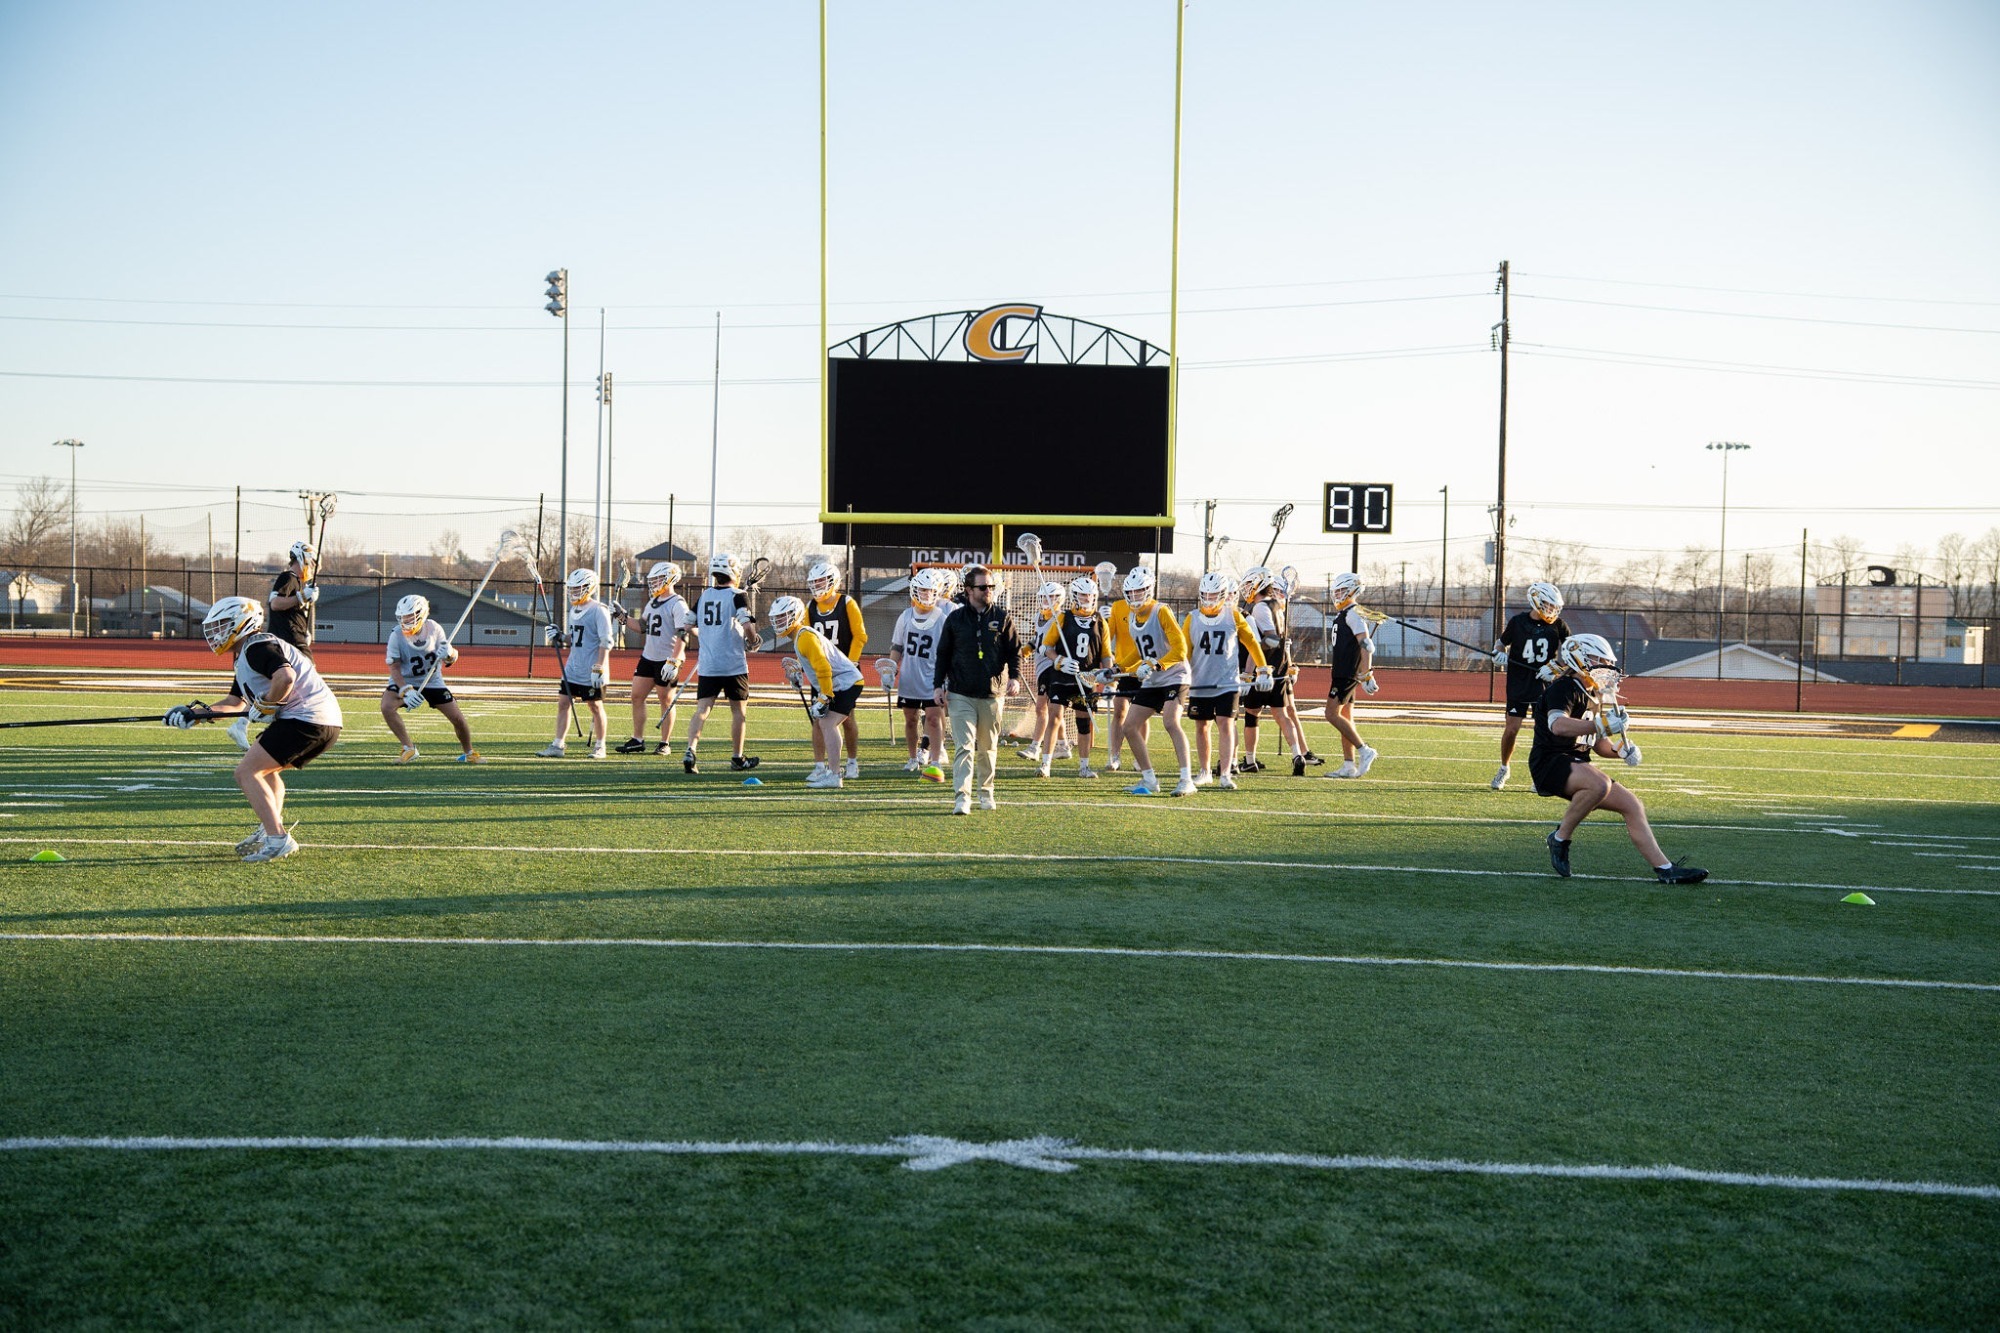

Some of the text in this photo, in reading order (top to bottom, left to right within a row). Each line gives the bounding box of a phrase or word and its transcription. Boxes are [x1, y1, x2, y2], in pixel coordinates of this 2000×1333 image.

[963, 303, 1044, 362] C
[1329, 486, 1388, 529] 80
[944, 550, 1034, 564] MCDNIE
[704, 601, 722, 626] 51
[906, 631, 934, 660] 52
[1075, 632, 1090, 659] 8
[1200, 630, 1226, 655] 47
[1522, 637, 1549, 664] 43
[410, 652, 438, 677] 23
